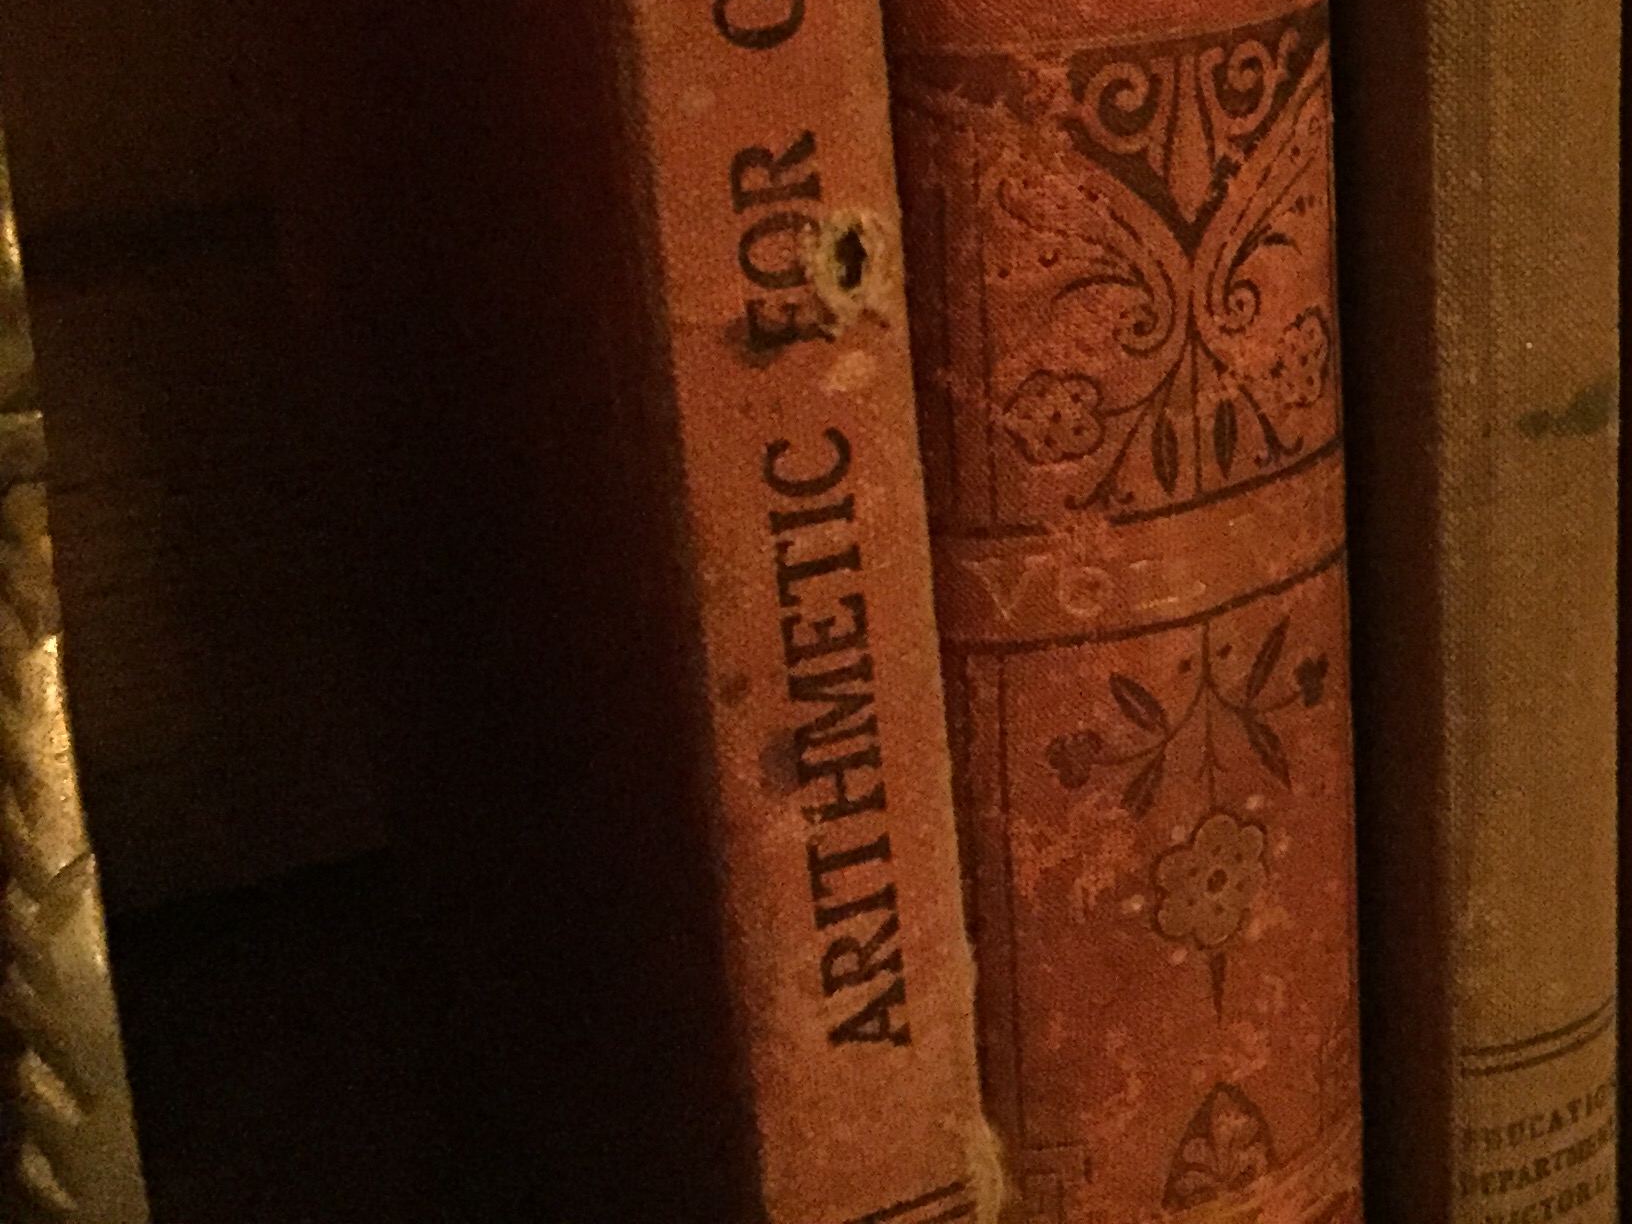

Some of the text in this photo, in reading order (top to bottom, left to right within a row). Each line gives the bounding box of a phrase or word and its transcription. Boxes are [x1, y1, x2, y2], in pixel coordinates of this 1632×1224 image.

[729, 128, 836, 352] FOR
[762, 425, 914, 1050] ARITHMETIC
[1460, 1082, 1610, 1152] EDUCATIO
